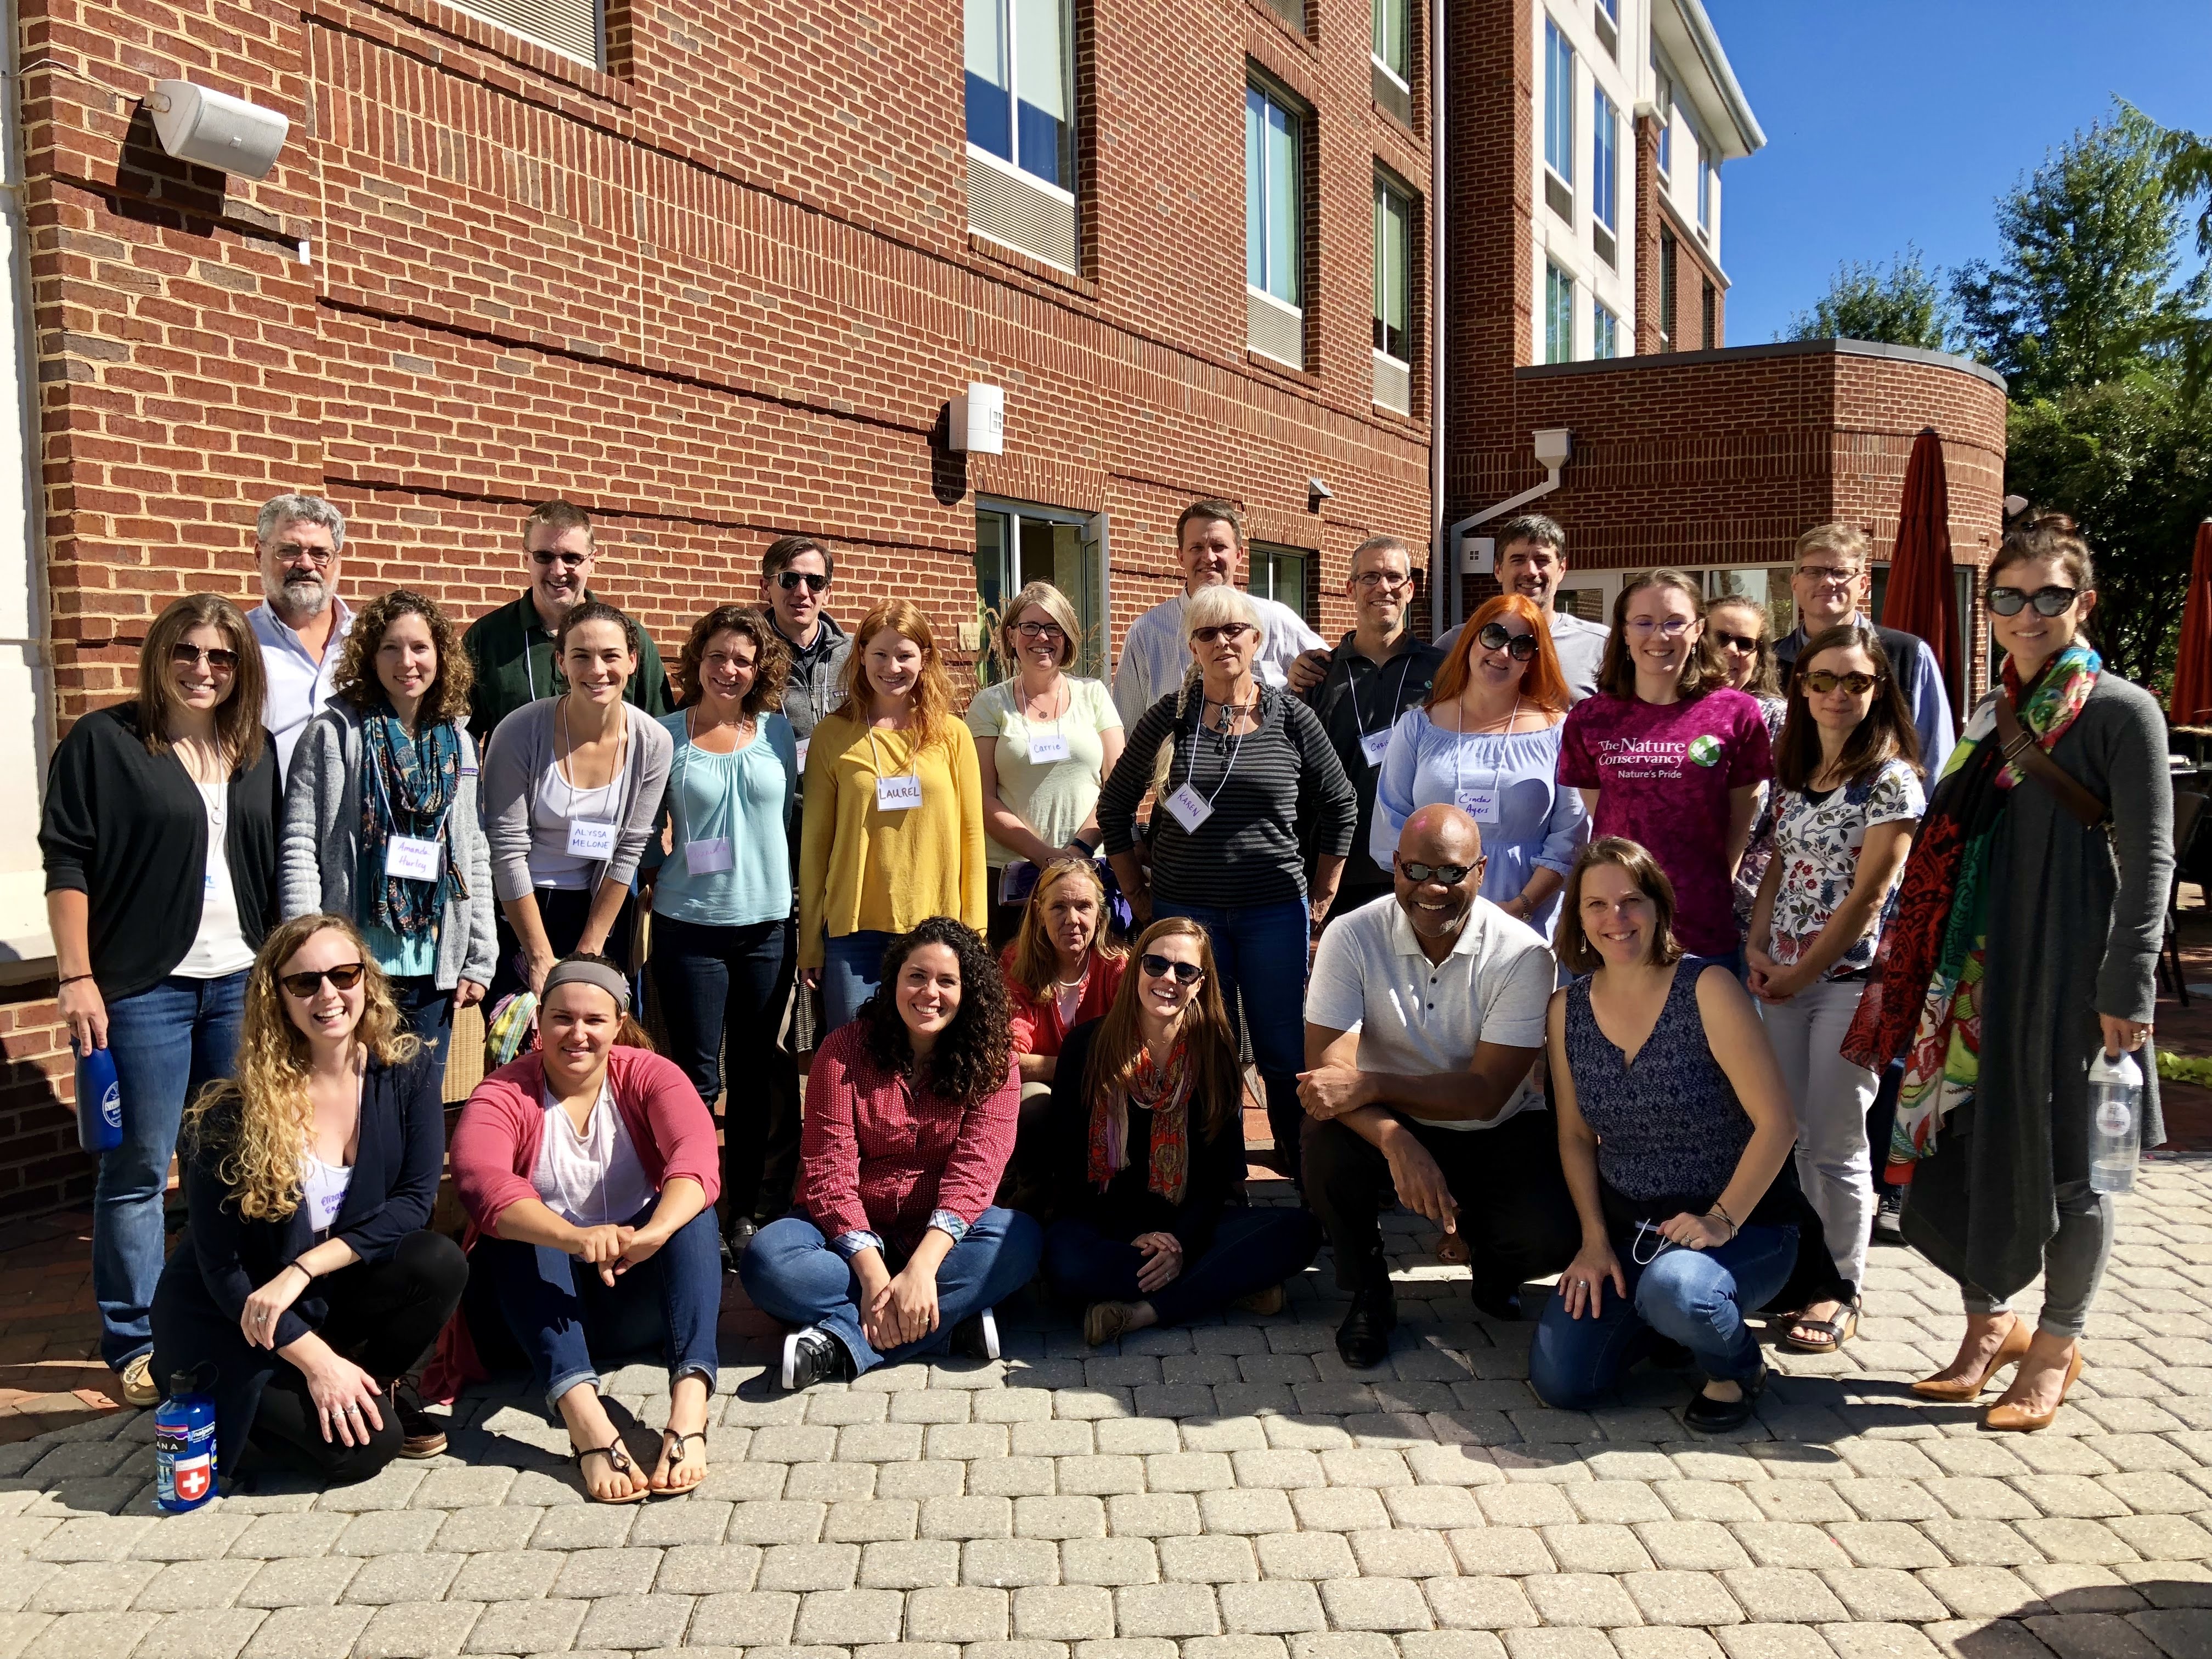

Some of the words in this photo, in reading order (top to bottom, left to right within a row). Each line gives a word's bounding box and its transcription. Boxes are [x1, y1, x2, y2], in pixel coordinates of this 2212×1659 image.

[1034, 741, 1061, 753] Carrie
[1598, 740, 1620, 752] The
[1619, 737, 1686, 753] Nature
[1599, 753, 1685, 769] Conservancy
[1618, 770, 1656, 778] Nature's
[1658, 770, 1683, 778] Pride
[879, 787, 919, 799] LAUREL
[1177, 790, 1201, 817] KAREN
[1465, 804, 1489, 817] Ayers
[574, 828, 606, 838] ALYSSA
[398, 842, 431, 855] Amanda
[572, 839, 611, 849] MELONE
[399, 855, 426, 873] Hurley
